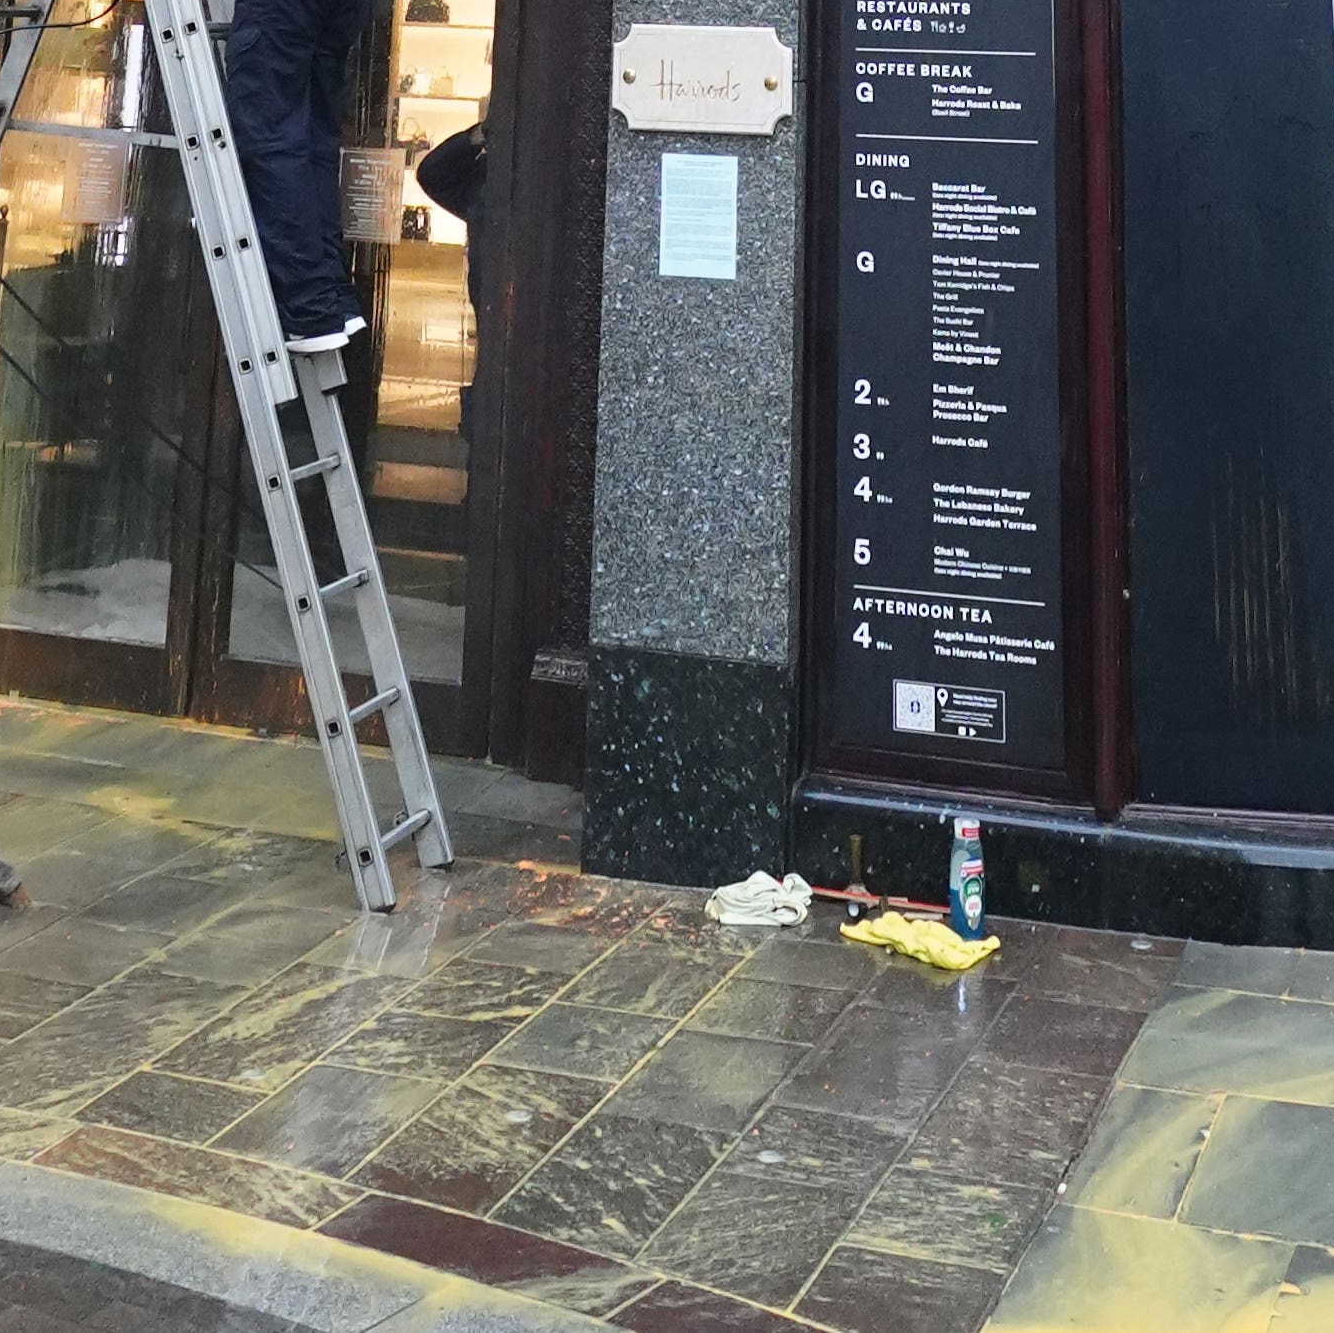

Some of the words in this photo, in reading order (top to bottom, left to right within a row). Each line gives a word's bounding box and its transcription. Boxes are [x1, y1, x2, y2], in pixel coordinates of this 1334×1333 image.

[856, 1, 971, 15] RESTAURANTS
[856, 18, 867, 30] &
[871, 17, 922, 32] CAFÉS
[855, 62, 915, 77] COFFEE
[920, 64, 972, 78] BREAK
[651, 59, 742, 102] Harrods
[855, 81, 874, 103] G
[932, 84, 948, 93] The
[949, 84, 977, 94] Coffee
[977, 86, 993, 95] Bar
[931, 98, 966, 108] Harrods
[967, 99, 991, 109] Roast
[992, 100, 999, 110] &
[999, 100, 1022, 110] Bake
[855, 153, 910, 168] DINING
[855, 179, 887, 199] LG
[931, 182, 970, 192] Baccarat
[971, 183, 986, 193] Bar
[932, 202, 963, 212] Harrods
[963, 203, 987, 213] Social
[932, 221, 962, 233] Tiffany
[962, 223, 982, 233] Blue
[982, 224, 999, 234] Box
[856, 250, 875, 273] G
[932, 254, 959, 266] Dining
[960, 256, 977, 266] Hall
[955, 343, 962, 352] &
[963, 343, 1002, 354] Chandon
[932, 352, 983, 365] Champagne
[983, 355, 1000, 365] Bar
[854, 378, 872, 405] 2
[932, 398, 967, 410] Pizzeria
[967, 401, 975, 411] &
[975, 401, 1007, 414] Pasqua
[932, 409, 973, 422] Prosecco
[973, 412, 989, 423] Bar
[853, 433, 871, 459] 3
[931, 434, 967, 446] Harrods
[967, 437, 988, 448] Café
[853, 475, 873, 502] 4
[932, 482, 965, 494] Gordon
[965, 485, 1000, 498] Ramsay
[1000, 487, 1031, 500] Burger
[932, 497, 950, 508] The
[951, 499, 993, 512] Lebanese
[993, 502, 1024, 516] Bakery
[932, 513, 968, 525] Harrods
[968, 516, 1001, 528] Garden
[1001, 518, 1037, 531] Terrace
[853, 537, 871, 565] 5
[933, 545, 954, 556] Chai
[955, 547, 969, 558] Wu
[852, 597, 954, 620] AFTERNOON
[959, 607, 993, 624] TEA
[852, 621, 873, 649] 4
[933, 629, 964, 642] Angelo
[964, 632, 989, 644] Musa
[1033, 638, 1055, 651] Café
[933, 644, 951, 656] The
[951, 647, 988, 660] Harrods
[988, 650, 1006, 662] Tea
[1006, 652, 1037, 665] Rooms
